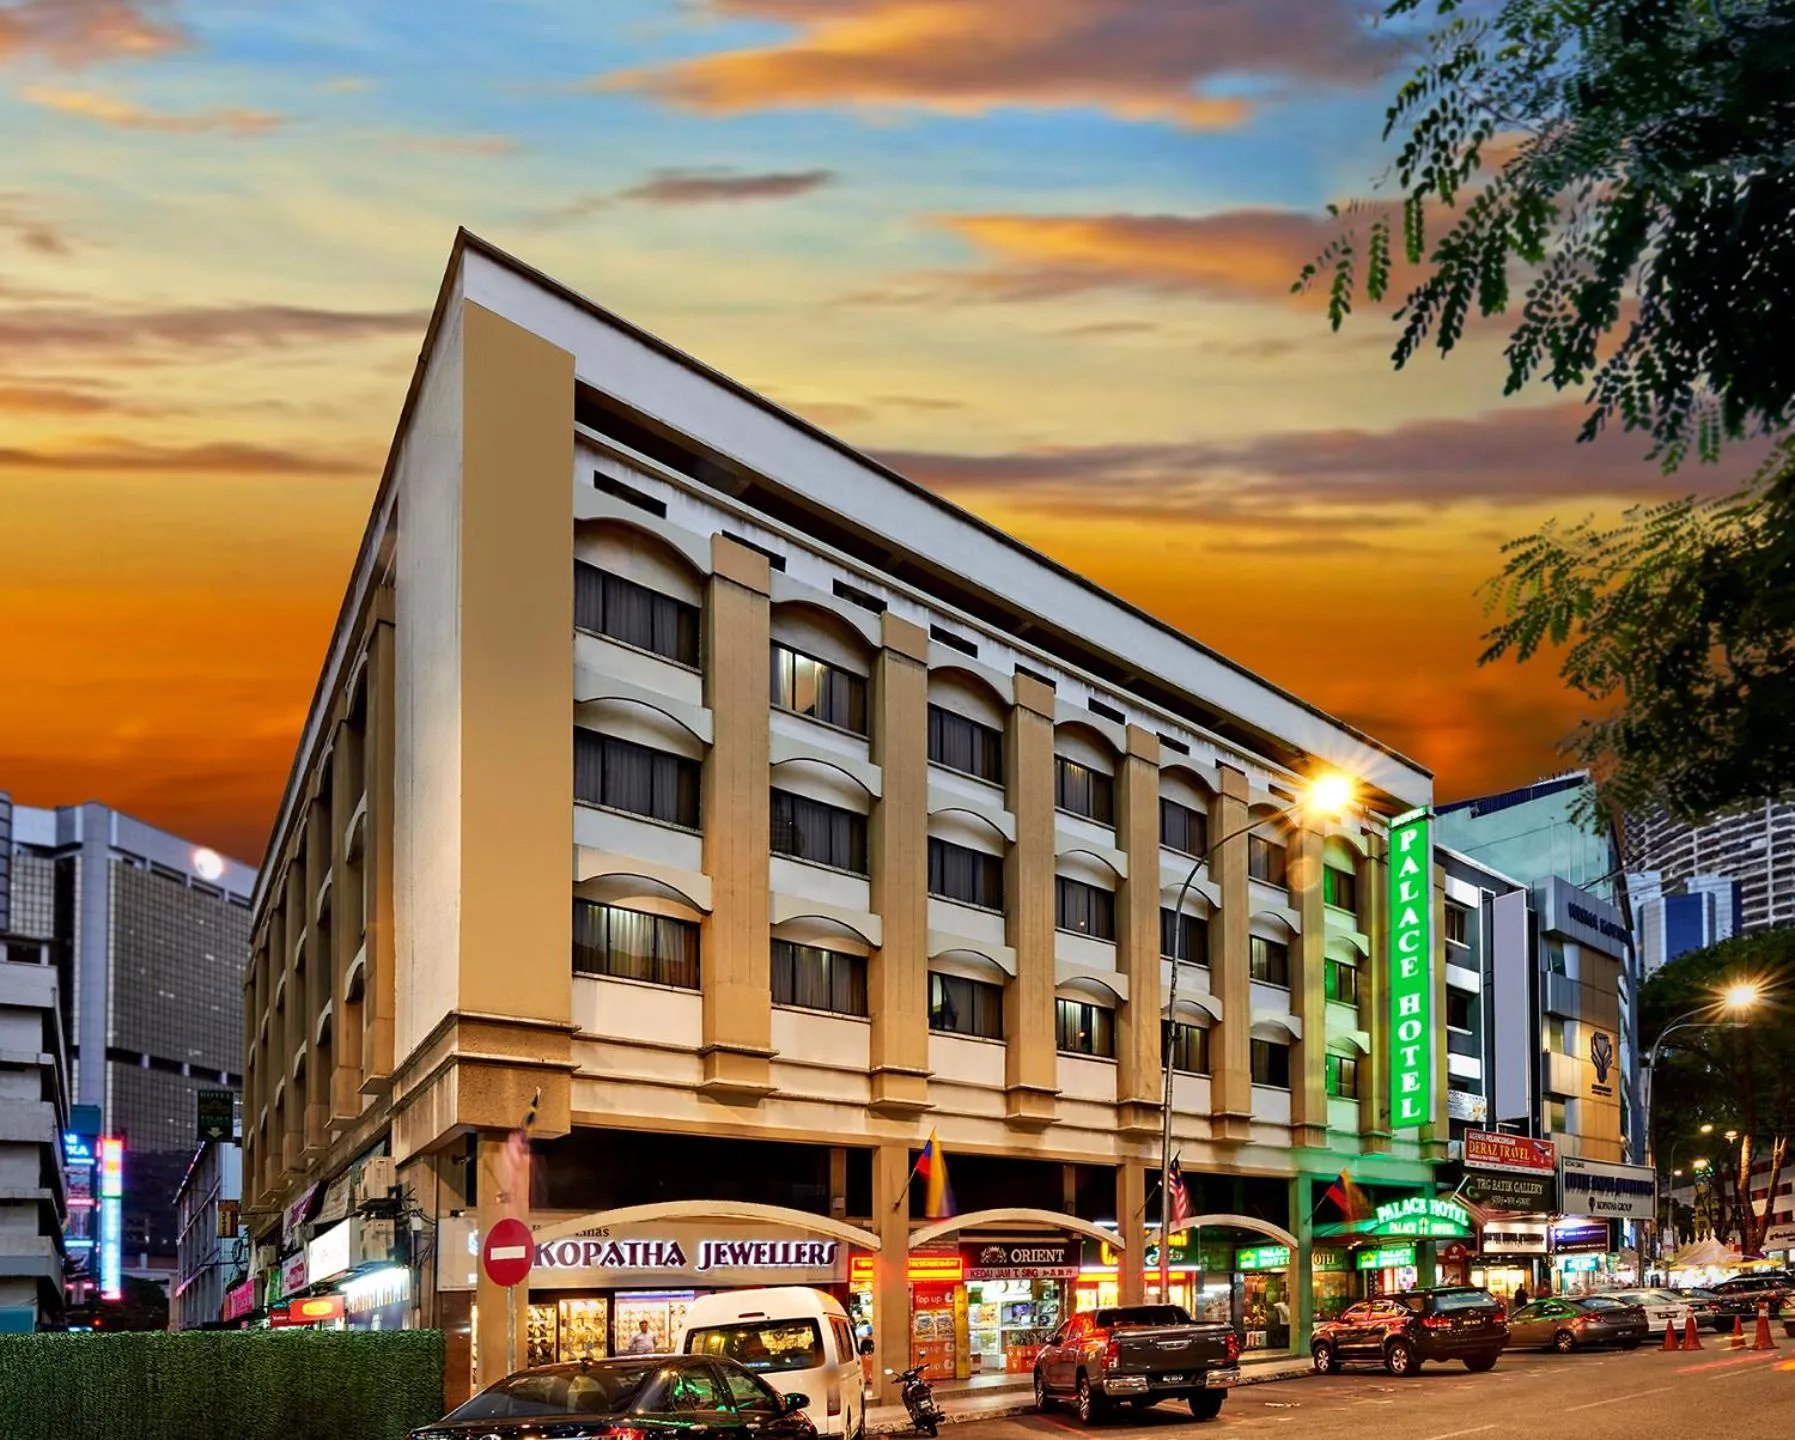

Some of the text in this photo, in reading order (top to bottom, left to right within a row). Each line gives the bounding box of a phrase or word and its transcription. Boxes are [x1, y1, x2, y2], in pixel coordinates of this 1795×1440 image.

[1398, 829, 1420, 978] PALACE
[1397, 993, 1422, 1119] HOTEL
[1469, 1141, 1498, 1156] DERAZ
[1500, 1145, 1530, 1160] TRAVEL
[1514, 1181, 1543, 1194] GALLERY
[1376, 1197, 1427, 1224] PALACE
[1430, 1198, 1469, 1226] HOTEL
[533, 1241, 840, 1270] KOPATHA JEWELLERS
[1010, 1248, 1065, 1263] ORIENT
[1313, 1253, 1336, 1265] OTEL
[969, 1269, 993, 1278] KEDAI
[995, 1269, 1010, 1278] JAM
[915, 1295, 942, 1305] Top up
